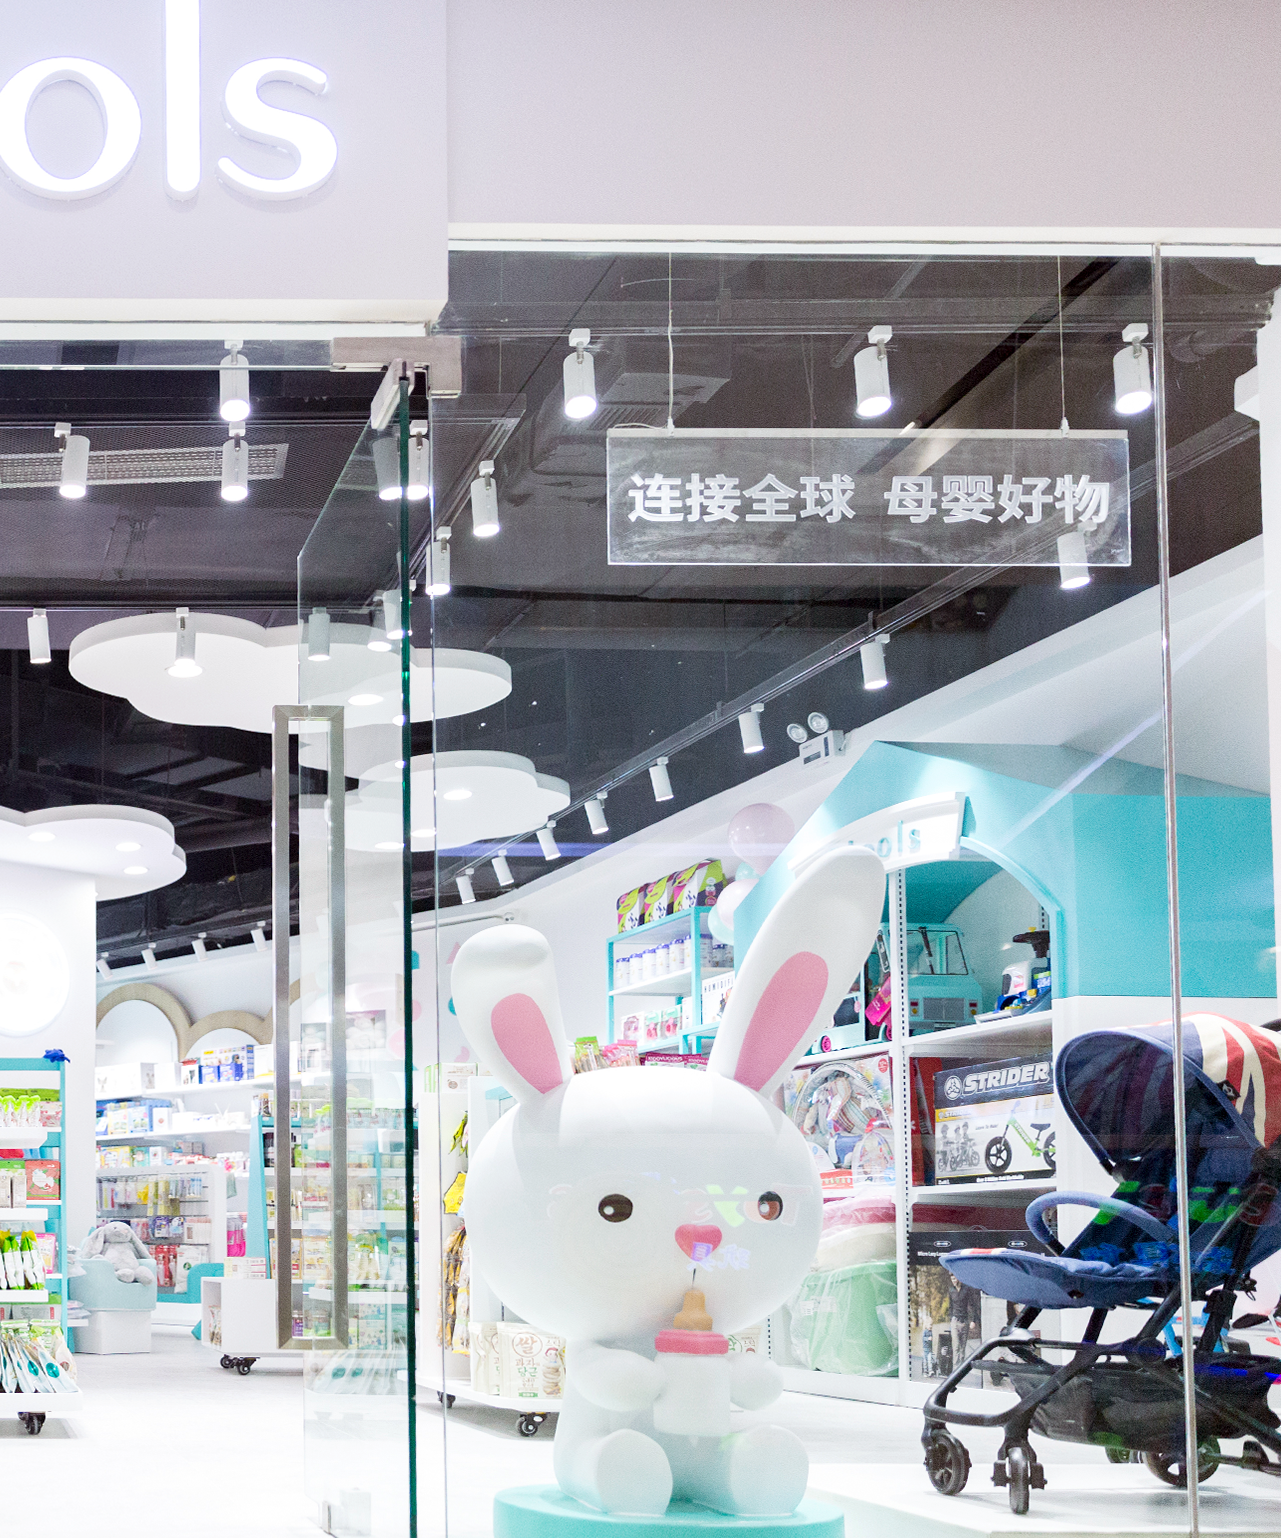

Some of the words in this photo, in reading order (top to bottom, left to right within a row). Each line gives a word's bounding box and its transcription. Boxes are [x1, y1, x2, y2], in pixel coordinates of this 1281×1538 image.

[628, 473, 856, 524] 连接全球
[883, 473, 1111, 525] 母婴好物
[704, 978, 734, 993] HUMIDIFI
[963, 1062, 1050, 1095] STRIDER
[516, 1335, 537, 1354] 쌀
